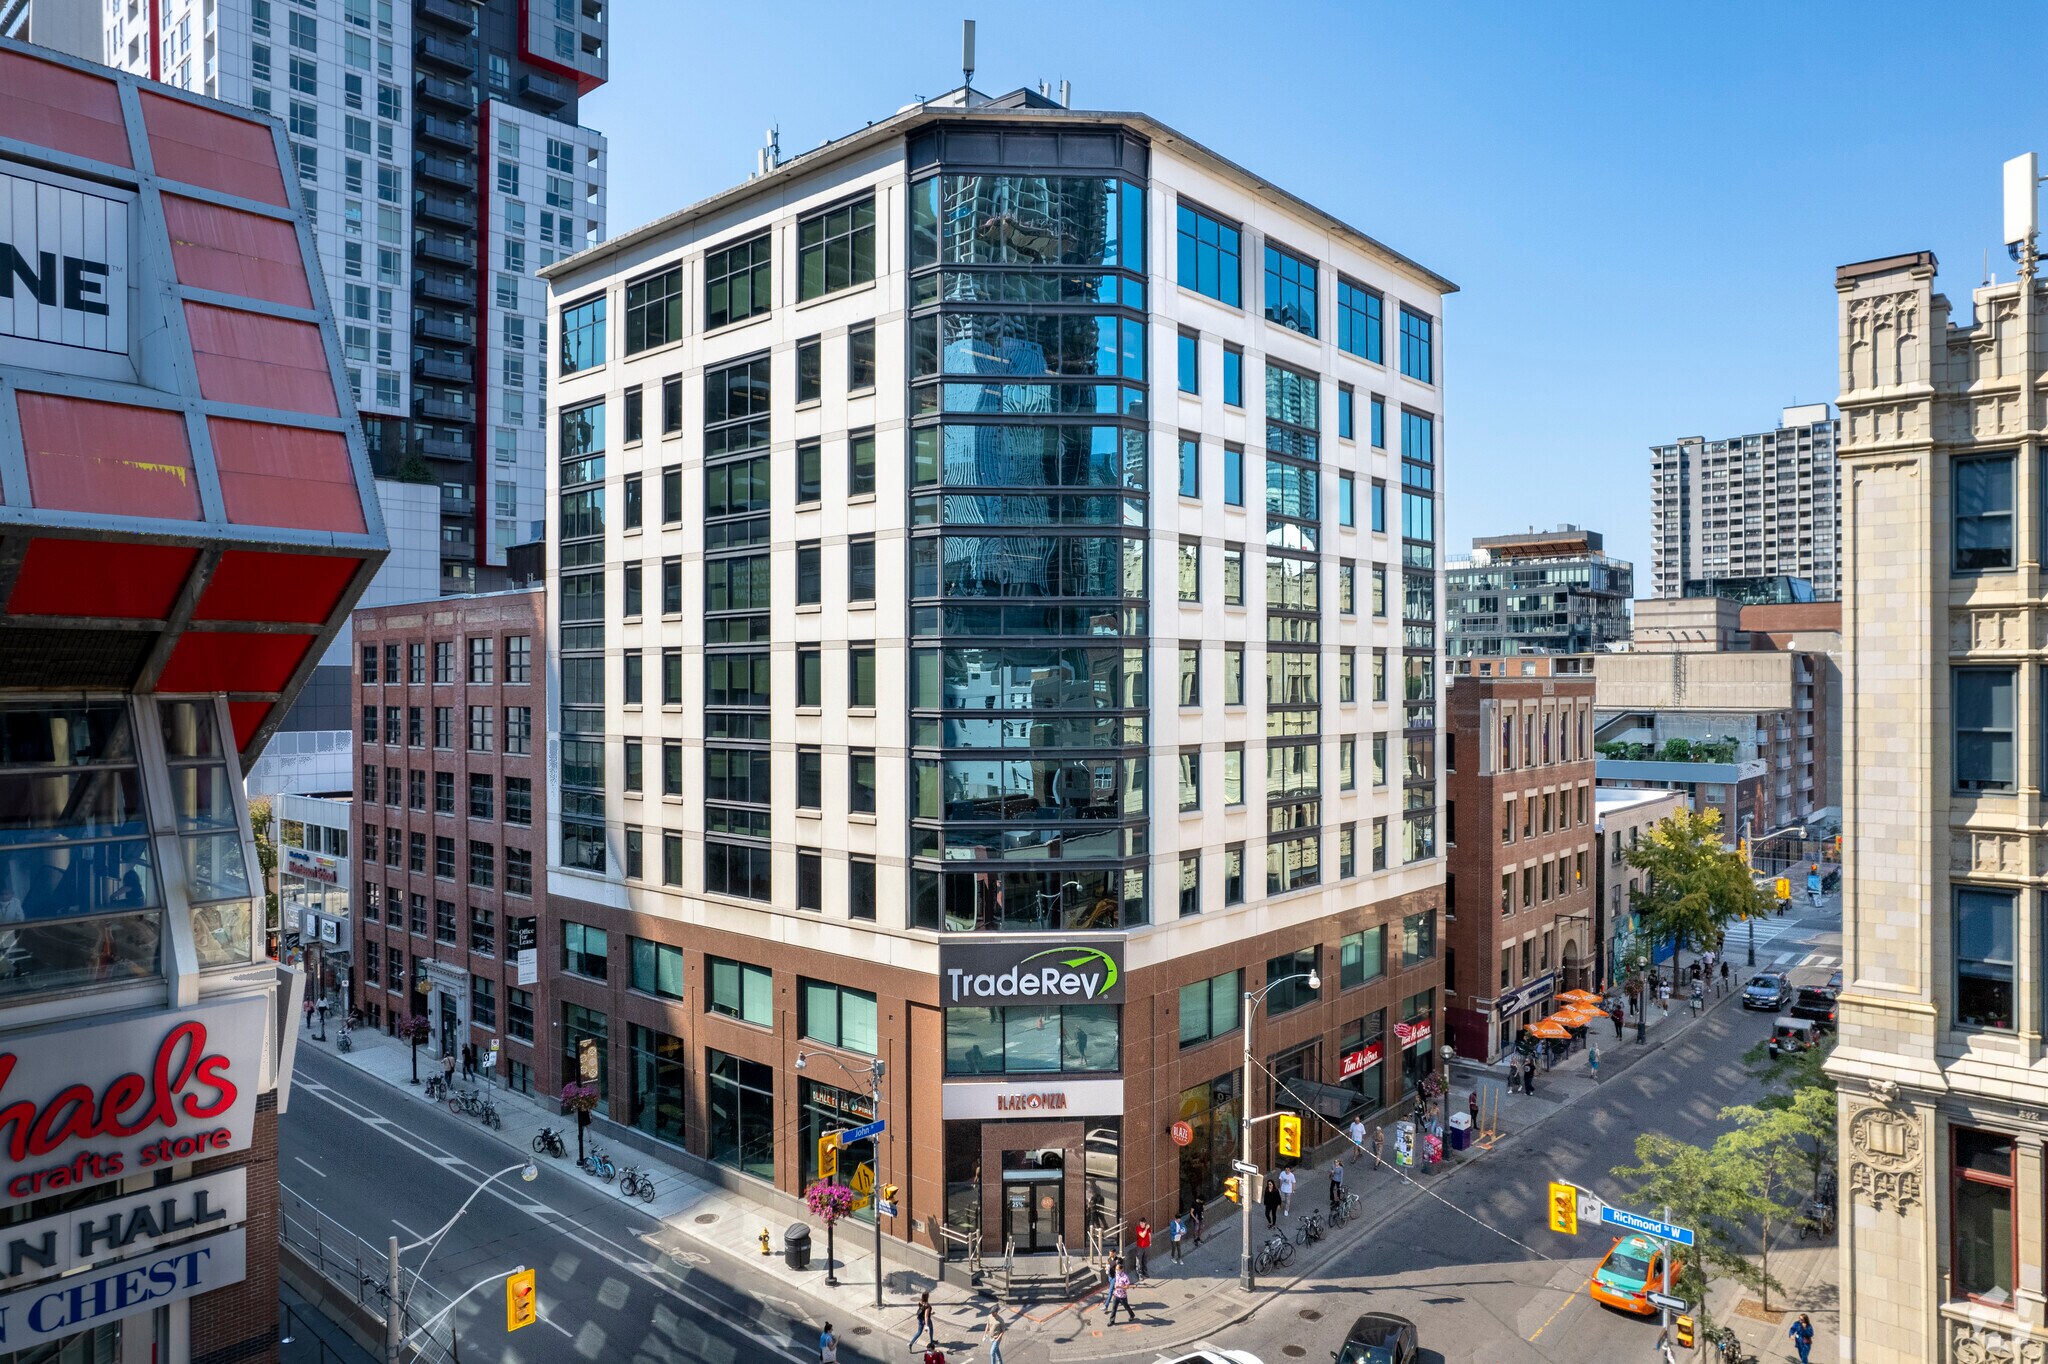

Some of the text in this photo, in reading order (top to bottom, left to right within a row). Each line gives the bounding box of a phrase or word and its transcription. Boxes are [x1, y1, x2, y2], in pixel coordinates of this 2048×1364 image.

[948, 965, 1099, 1002] TradeRev
[1344, 1056, 1357, 1073] Tim
[998, 1092, 1067, 1110] BLAZE PIZZA
[854, 1127, 870, 1138] John
[1173, 1126, 1188, 1139] BLAZE
[8, 1127, 231, 1198] crafts store
[0, 1190, 227, 1281] N HALL
[1613, 1211, 1661, 1233] Richmond
[1671, 1227, 1681, 1239] W
[28, 1248, 210, 1332] CHEST
